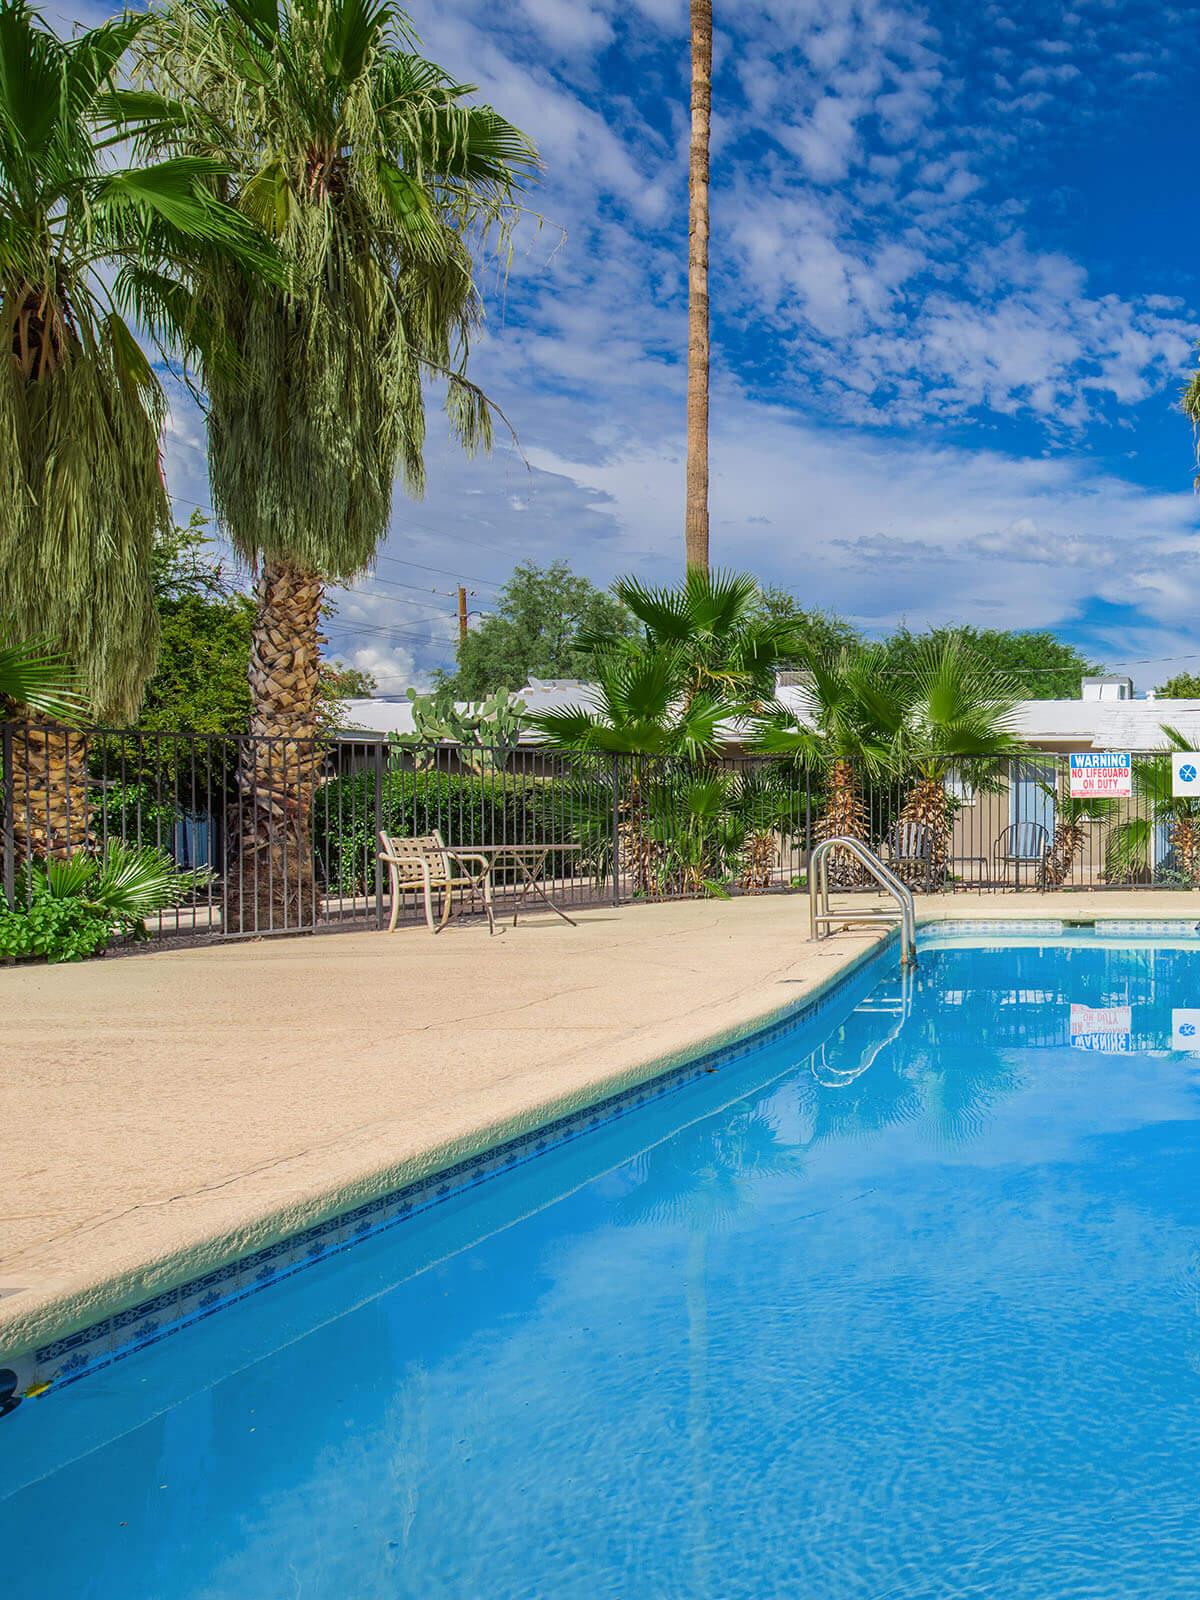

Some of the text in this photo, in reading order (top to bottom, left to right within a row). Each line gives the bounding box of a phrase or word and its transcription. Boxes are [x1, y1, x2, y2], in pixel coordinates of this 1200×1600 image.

[1074, 754, 1127, 767] WARNING
[1072, 768, 1129, 778] NO LIFEGUARD
[1083, 779, 1119, 789] ON DUTY
